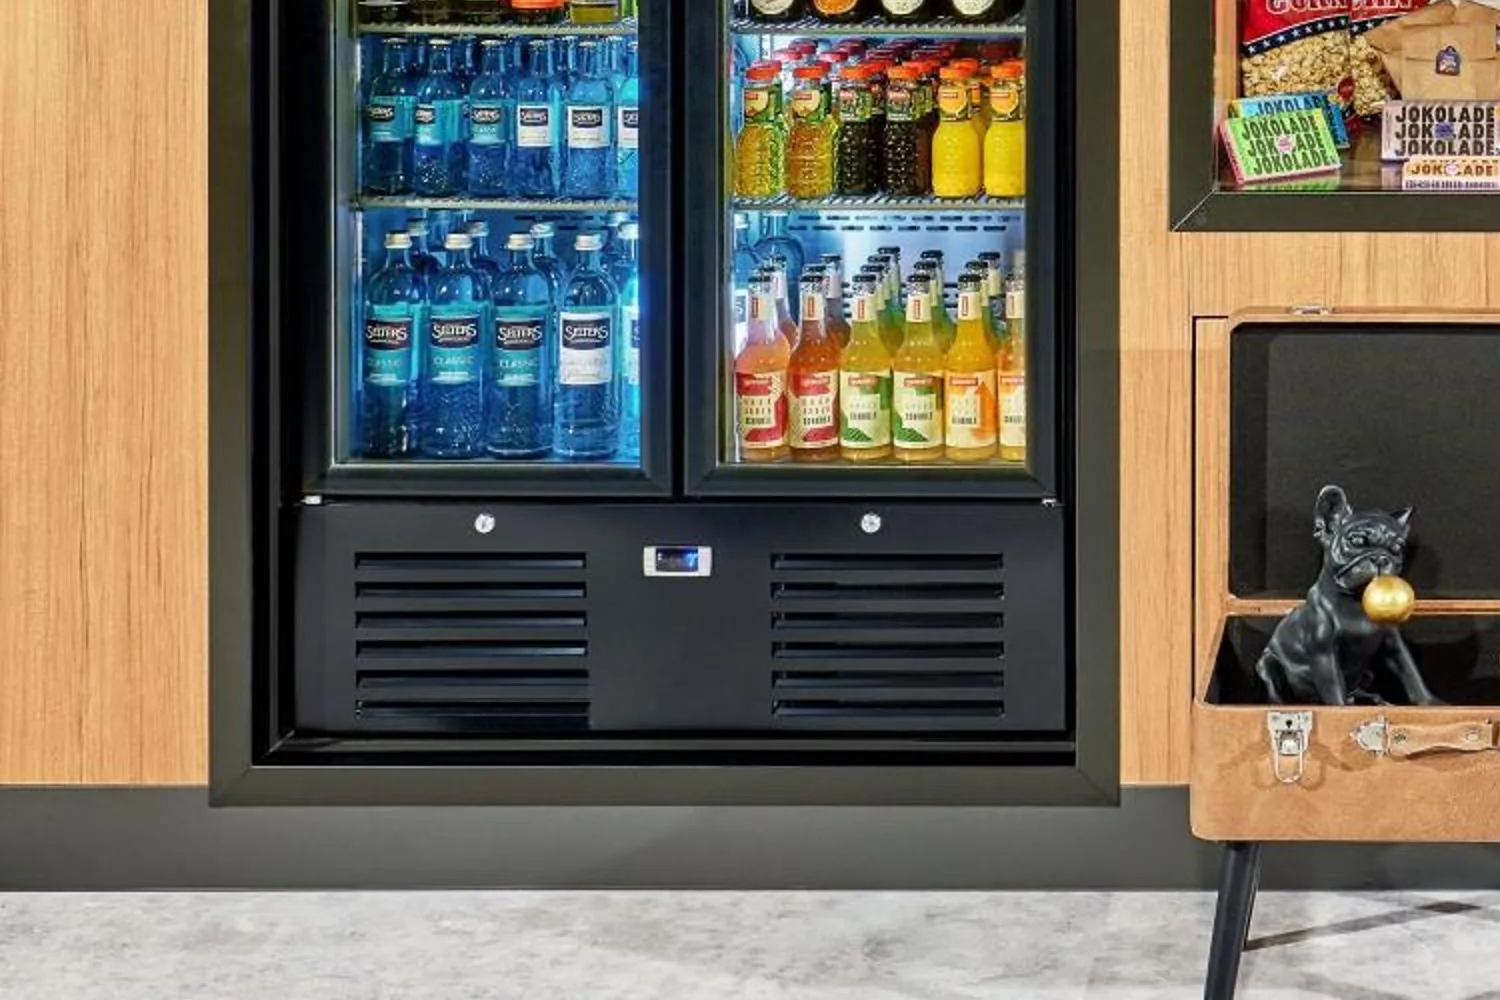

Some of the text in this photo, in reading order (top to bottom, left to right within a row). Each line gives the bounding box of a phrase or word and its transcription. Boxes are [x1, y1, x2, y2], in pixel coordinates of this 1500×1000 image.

[1395, 106, 1495, 123] JOKOLADE
[1241, 114, 1319, 141] JOKOLADE
[1395, 123, 1495, 139] JOKADE
[1247, 131, 1325, 157] JOKADE
[1394, 140, 1495, 156] JOKOLADE
[1253, 149, 1331, 175] JOKOLADE
[1411, 164, 1493, 177] JOKADE
